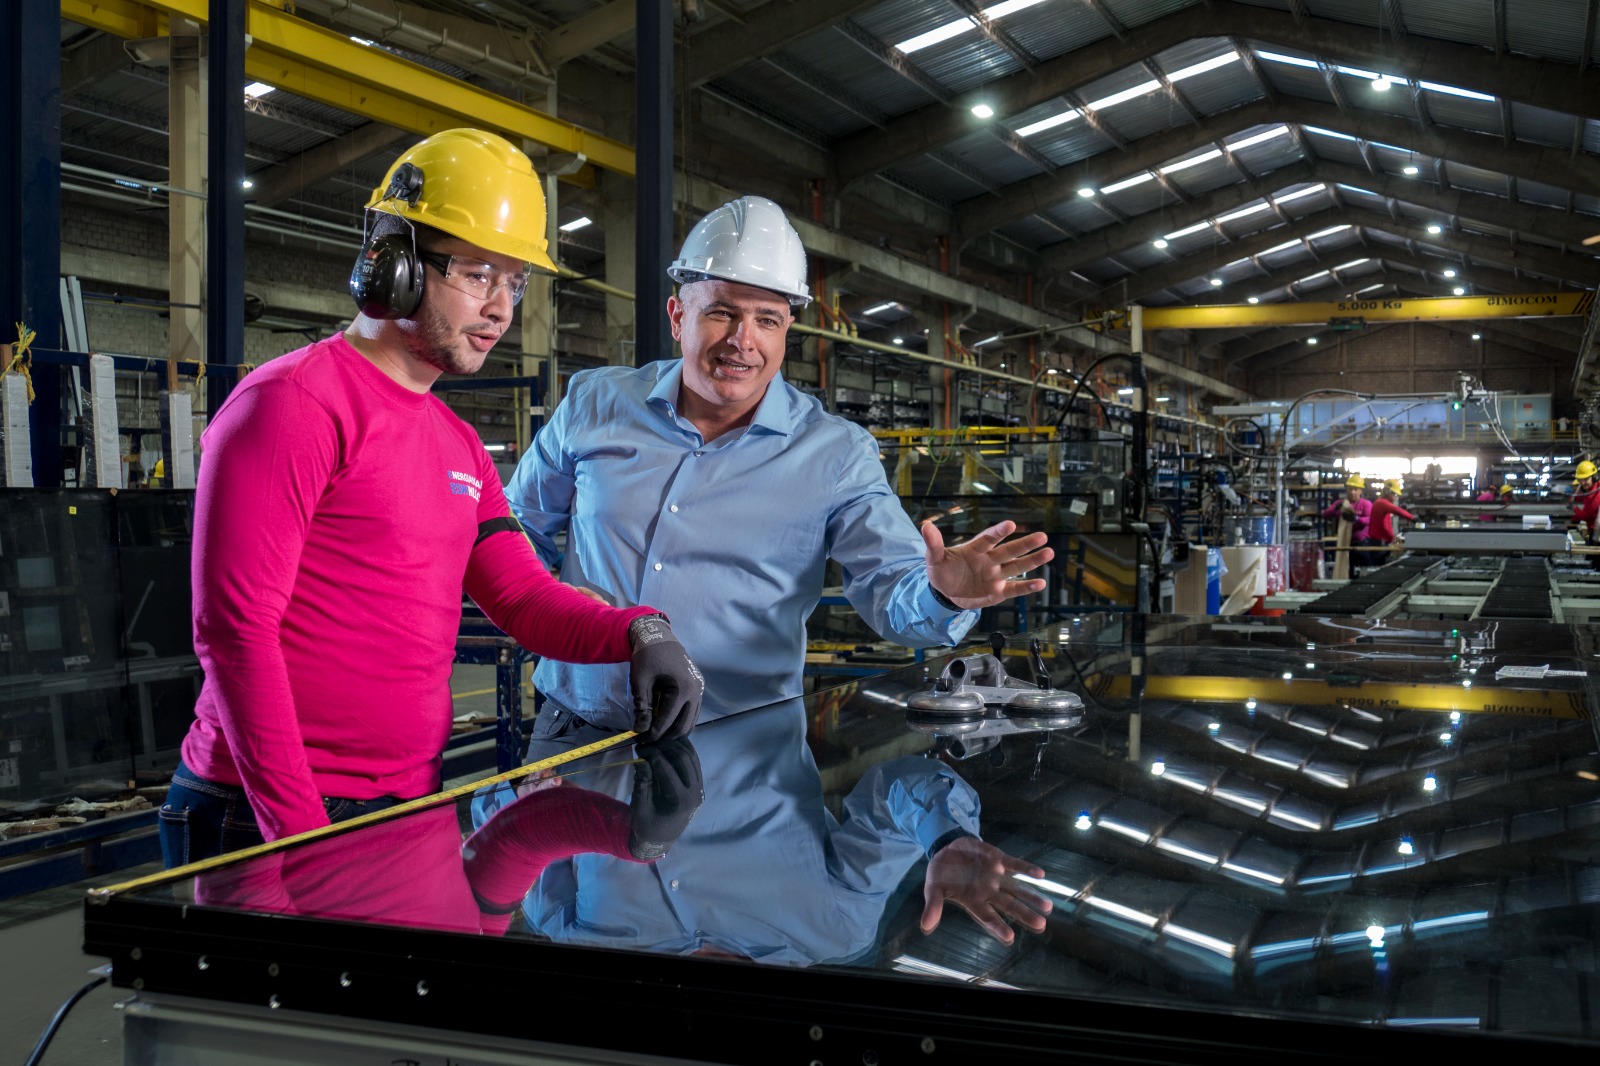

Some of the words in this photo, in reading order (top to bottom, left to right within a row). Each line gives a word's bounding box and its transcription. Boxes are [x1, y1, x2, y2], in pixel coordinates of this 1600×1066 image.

[362, 264, 374, 274] 101
[1338, 301, 1378, 311] 5.000
[1382, 301, 1402, 310] Kg
